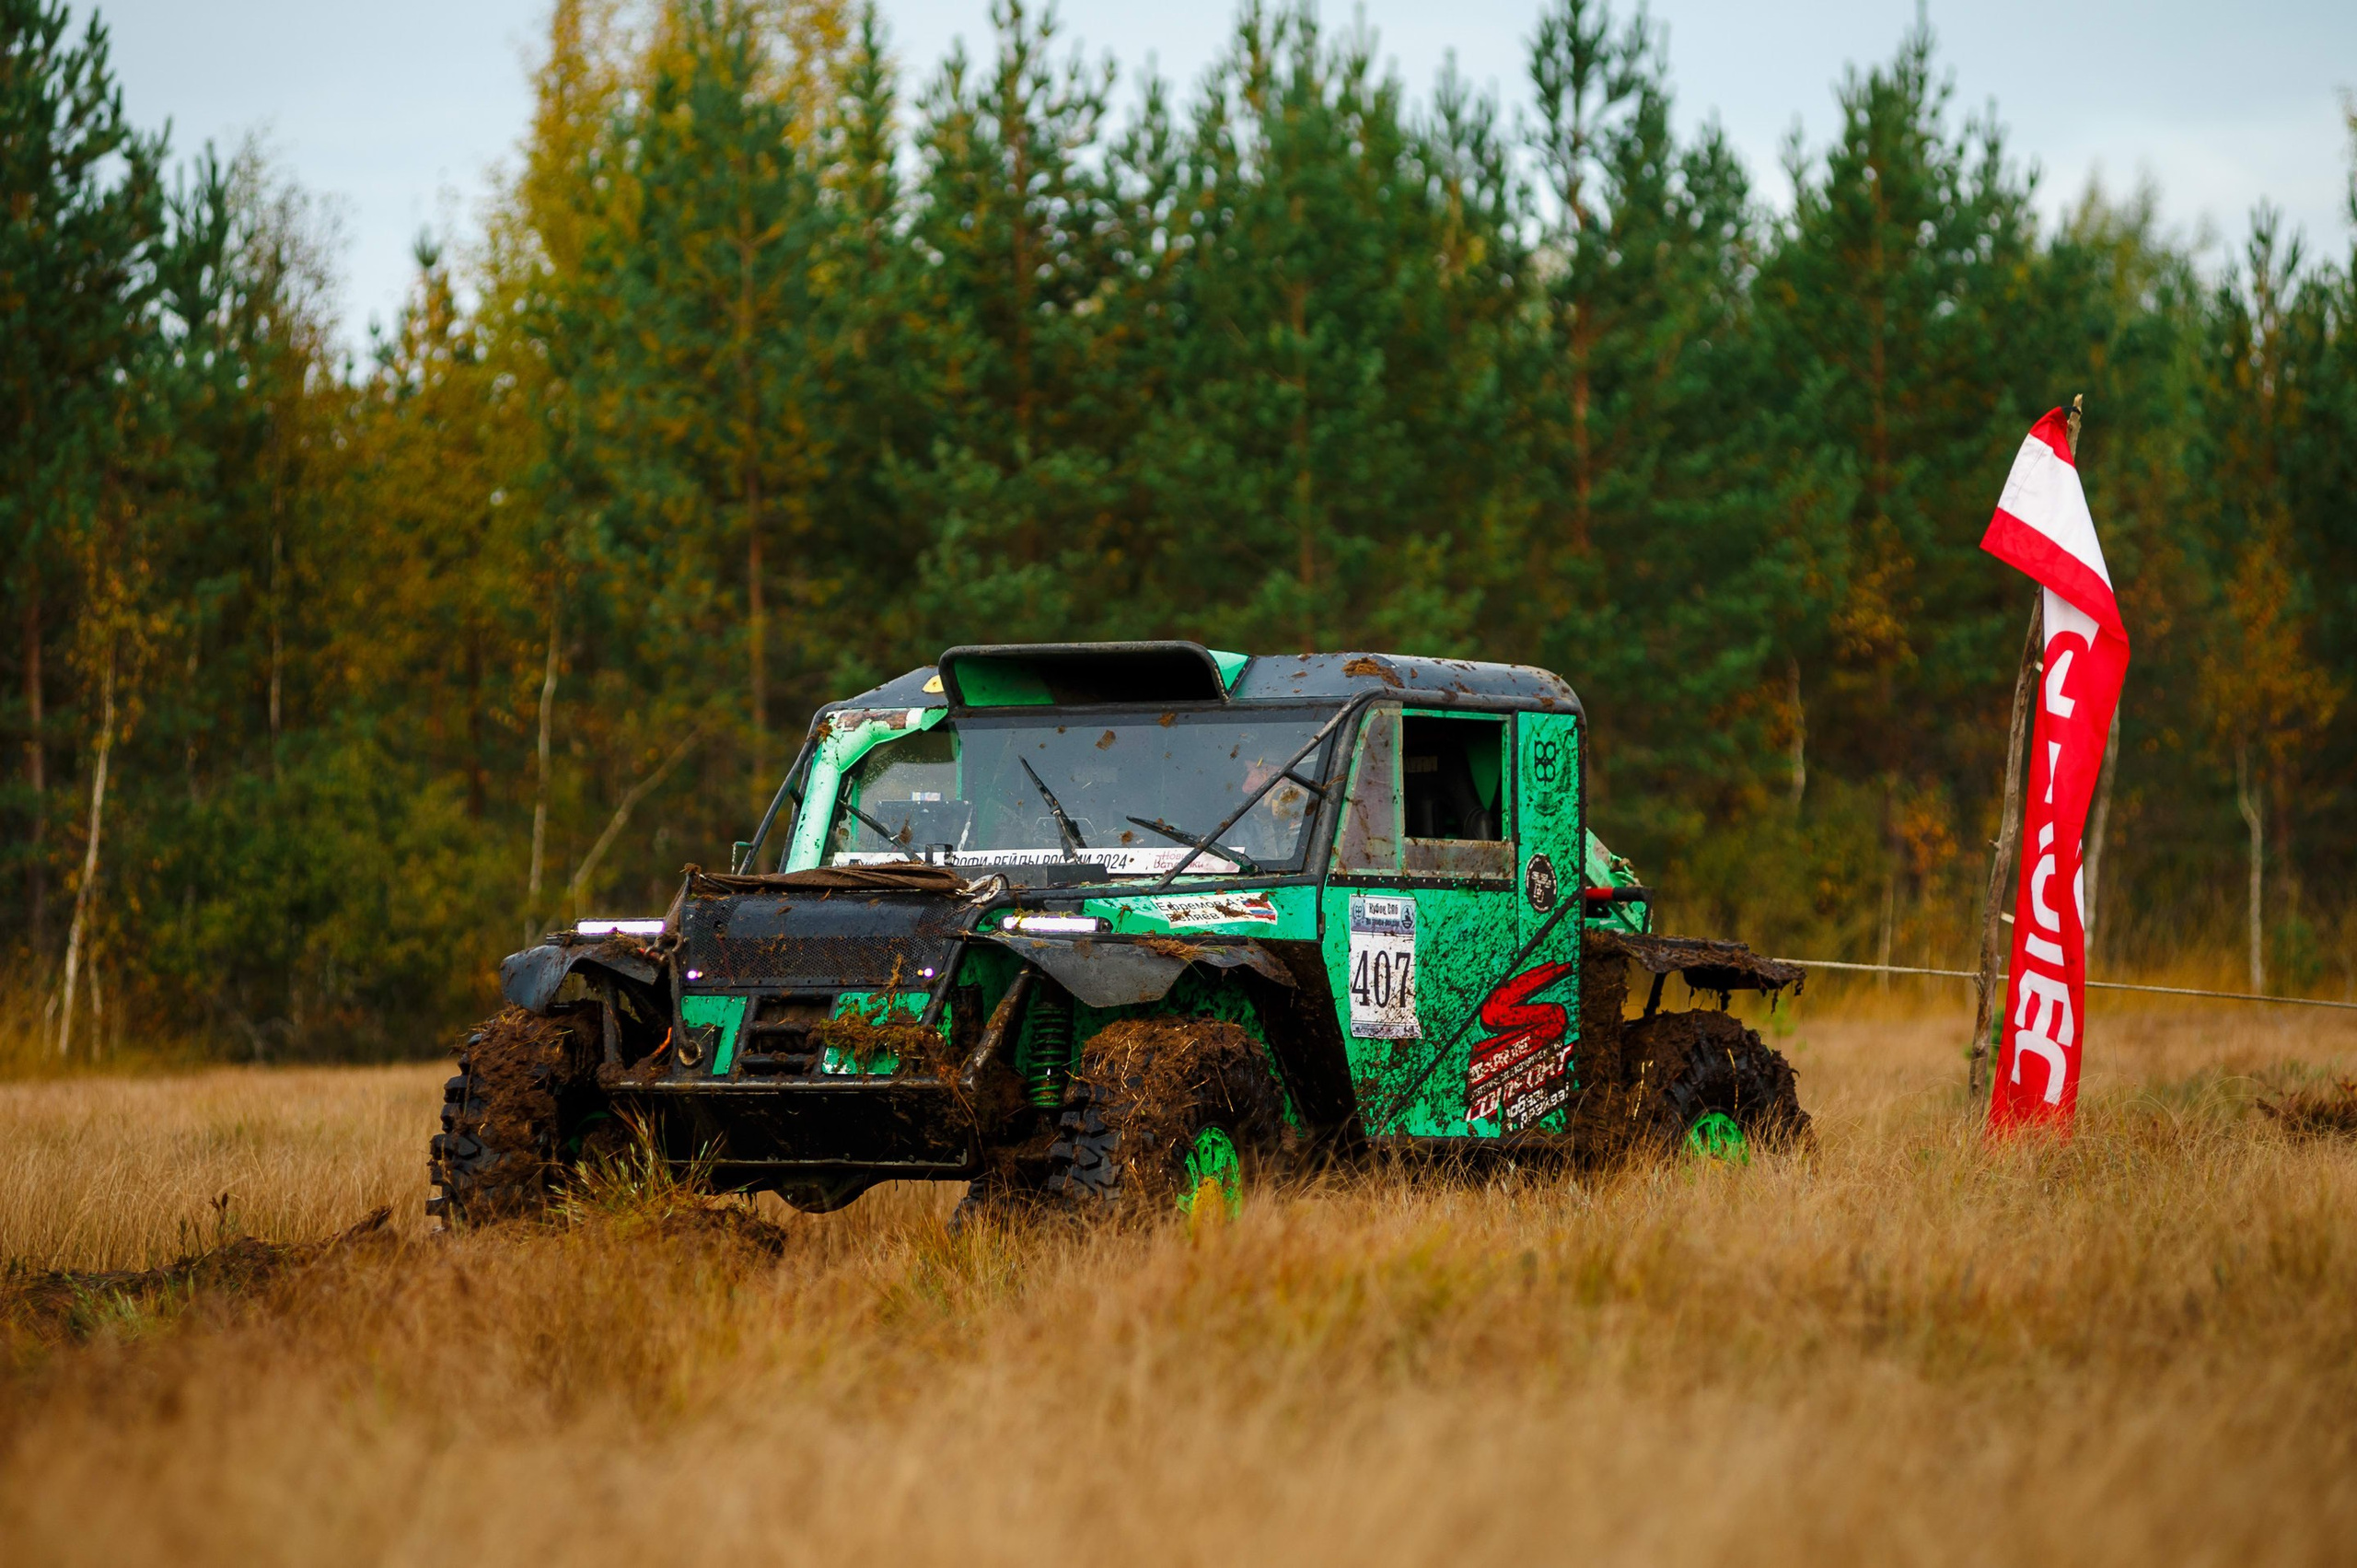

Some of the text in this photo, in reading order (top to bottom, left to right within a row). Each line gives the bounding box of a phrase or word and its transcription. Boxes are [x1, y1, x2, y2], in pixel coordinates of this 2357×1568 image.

[1096, 854, 1128, 870] 2024
[1155, 899, 1223, 912] Ефремов
[1352, 948, 1411, 1009] 407
